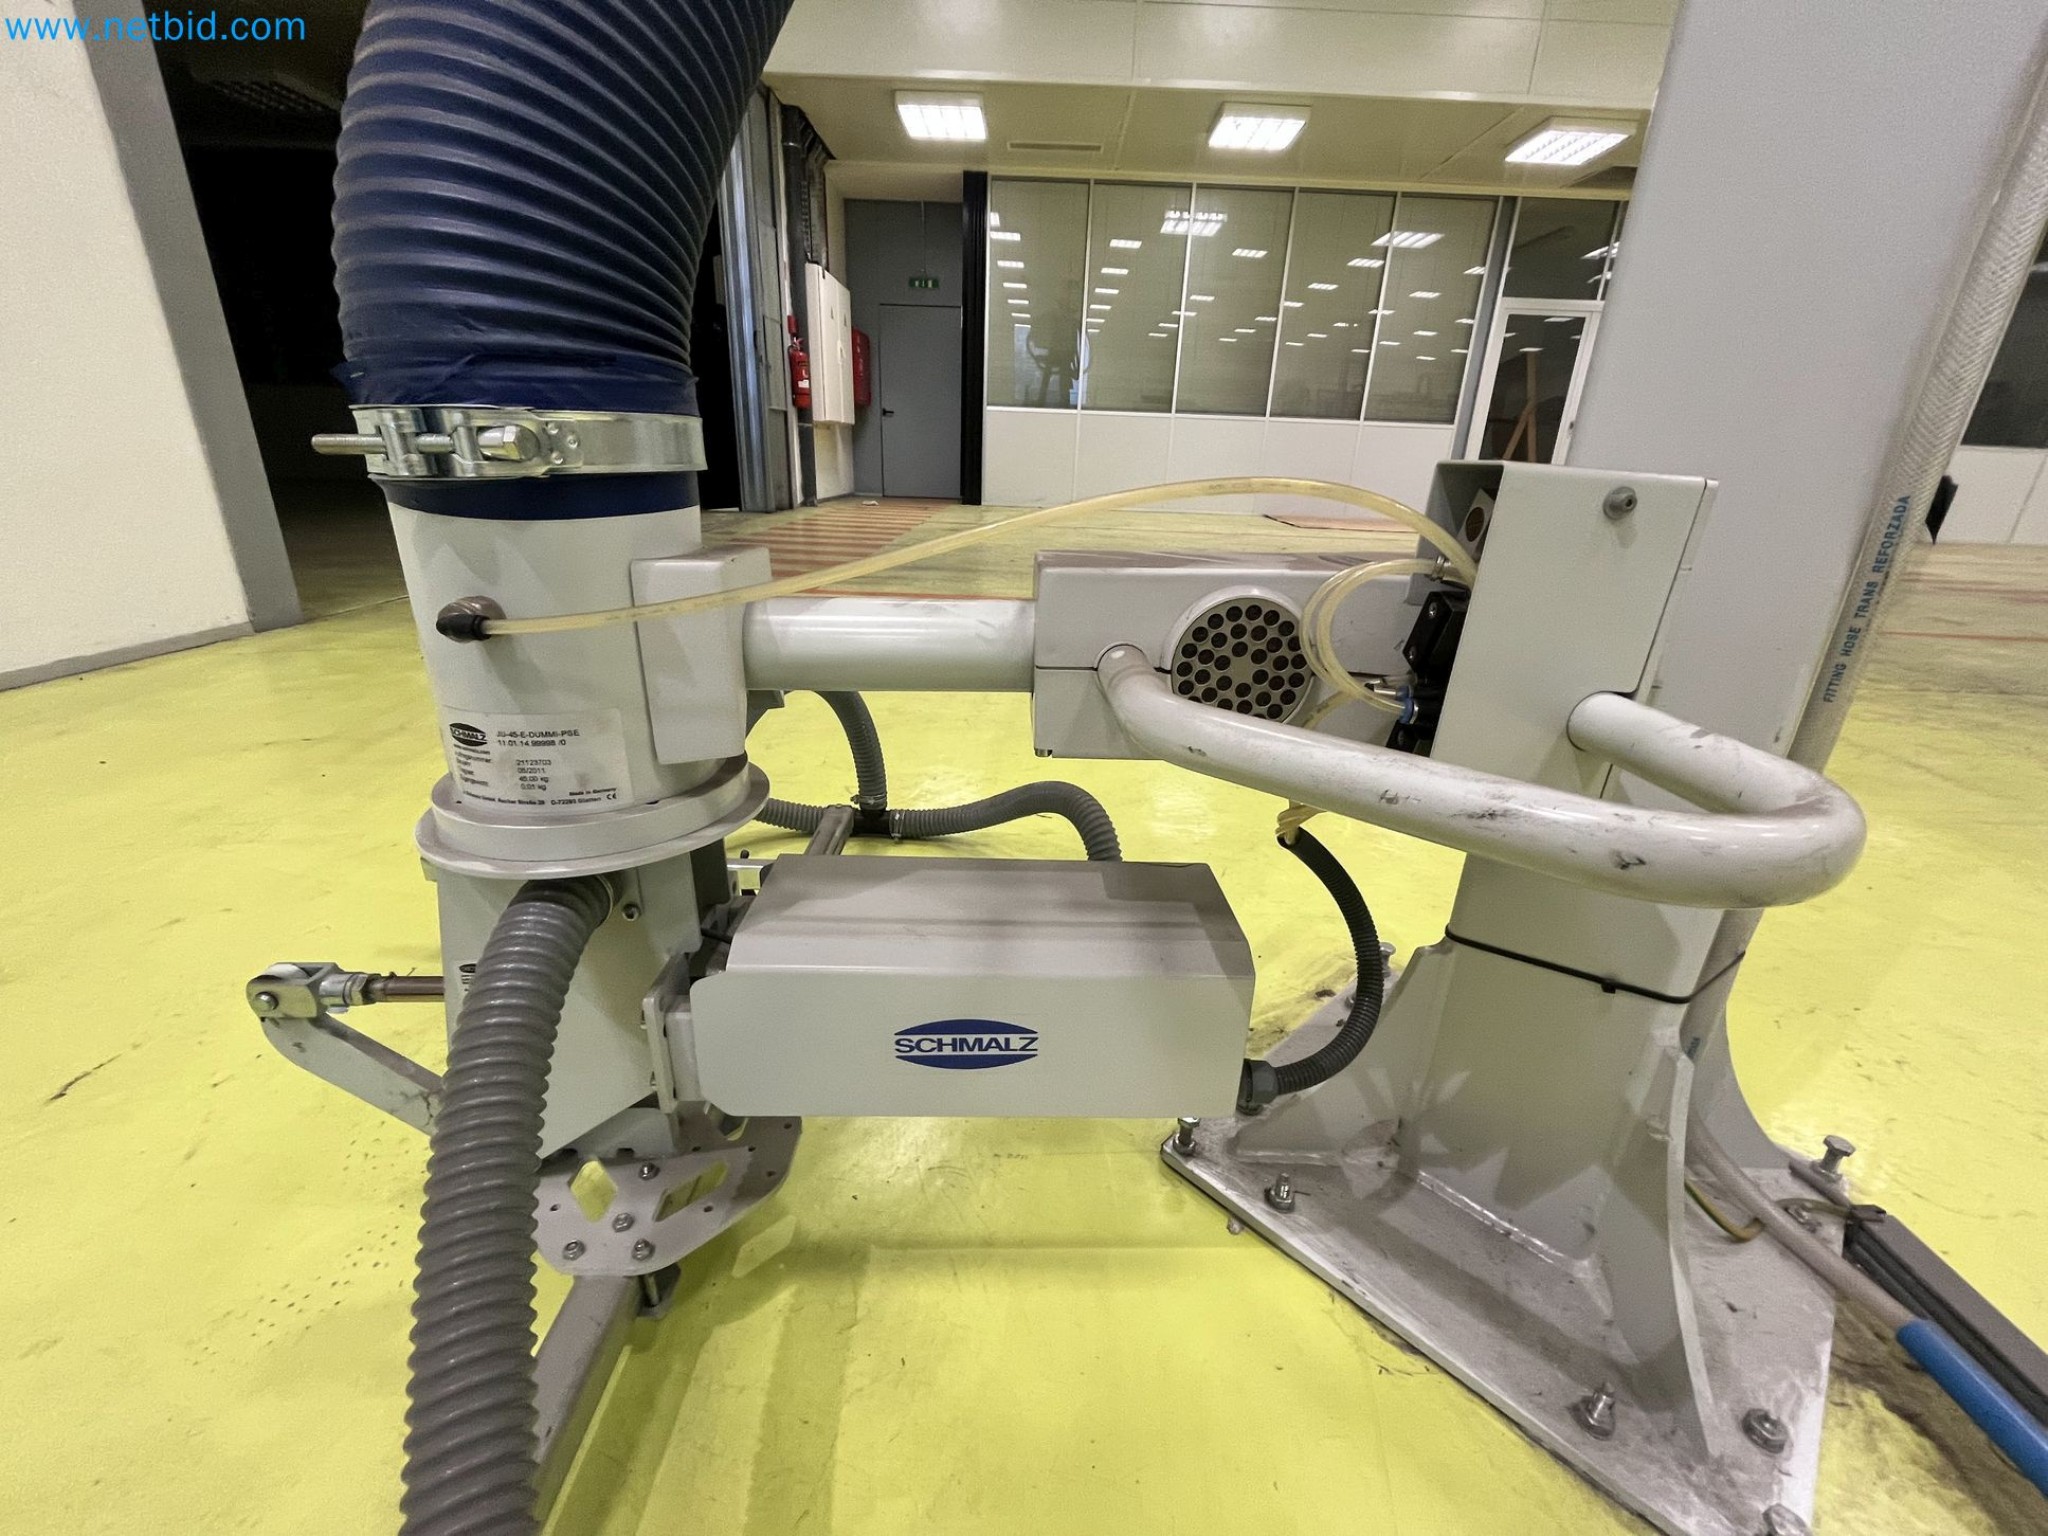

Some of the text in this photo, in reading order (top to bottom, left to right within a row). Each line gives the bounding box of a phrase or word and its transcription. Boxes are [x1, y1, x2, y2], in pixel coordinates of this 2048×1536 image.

[1823, 495, 1911, 703] FITTING HOSE TRANS REFORZADA
[894, 1036, 1039, 1054] SCHMALZ
